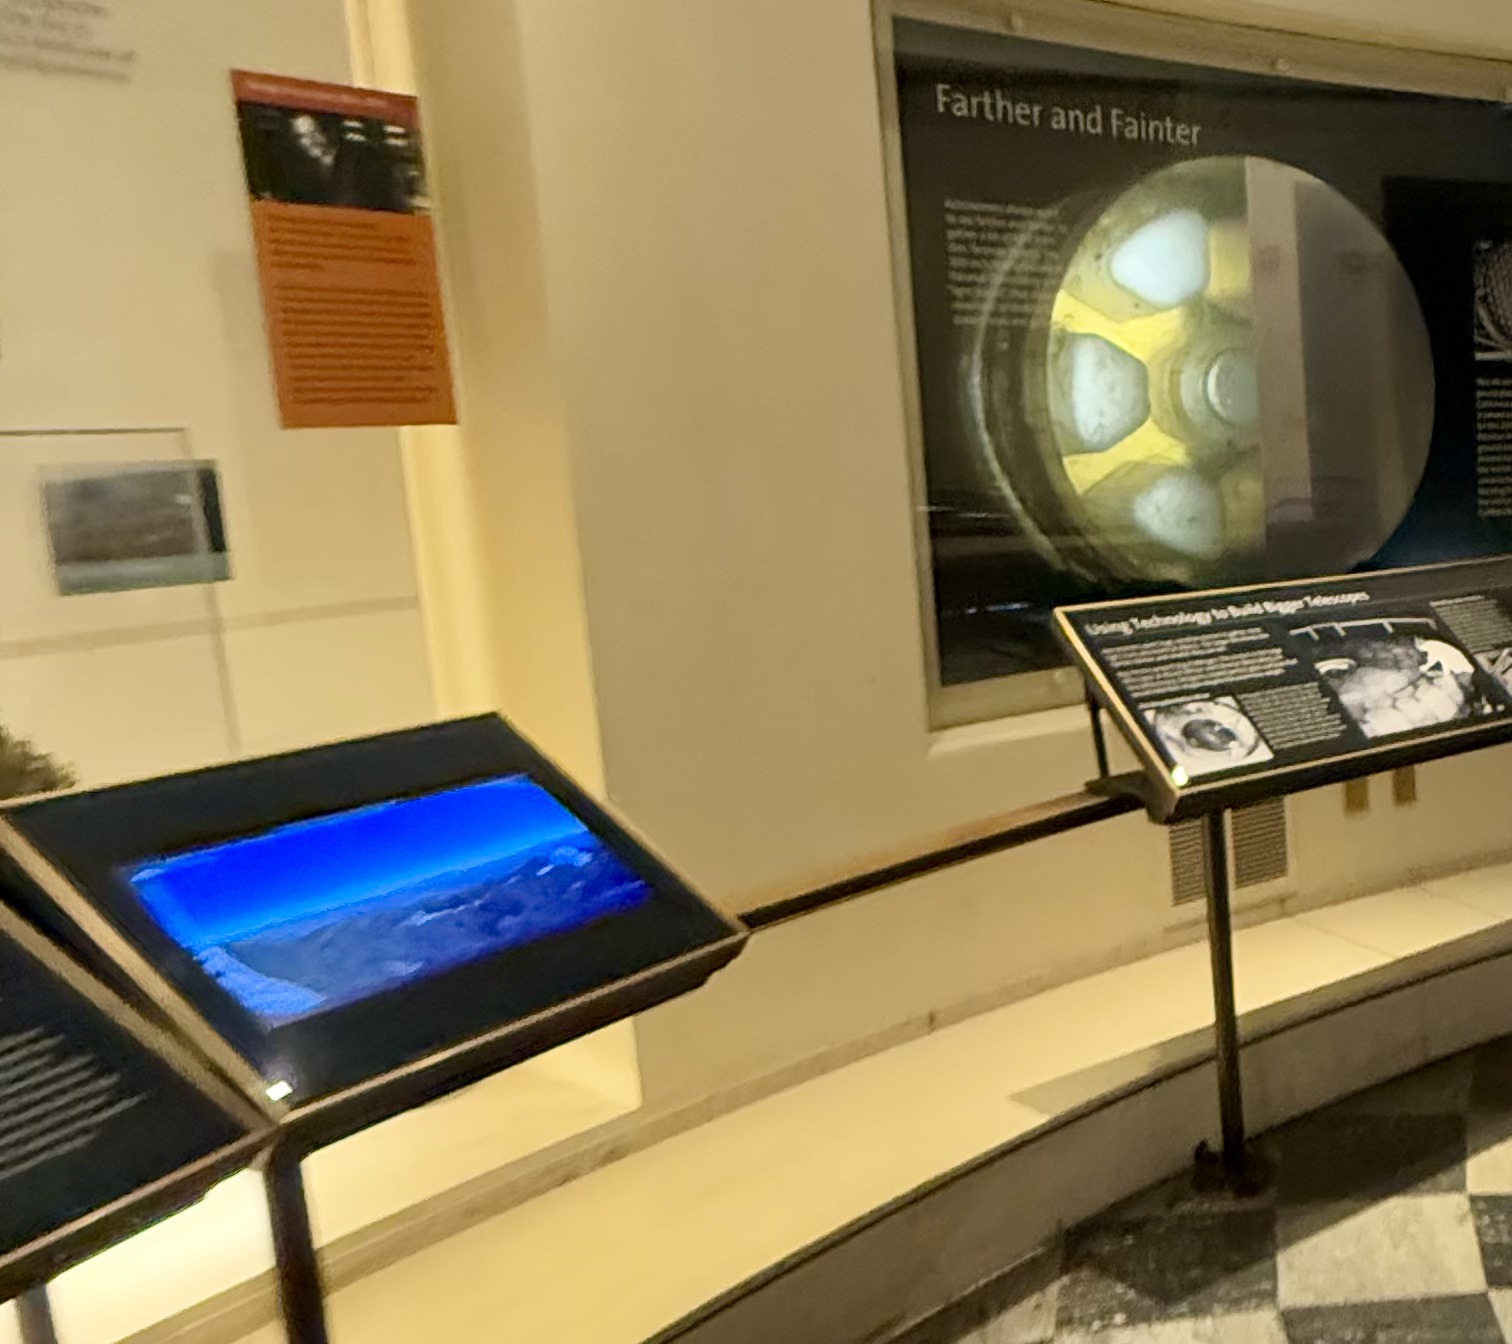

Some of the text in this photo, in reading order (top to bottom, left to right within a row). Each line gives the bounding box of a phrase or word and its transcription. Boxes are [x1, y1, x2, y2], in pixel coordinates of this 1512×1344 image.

[936, 83, 1201, 147] Farther and Fainter
[1130, 613, 1212, 629] Technology
